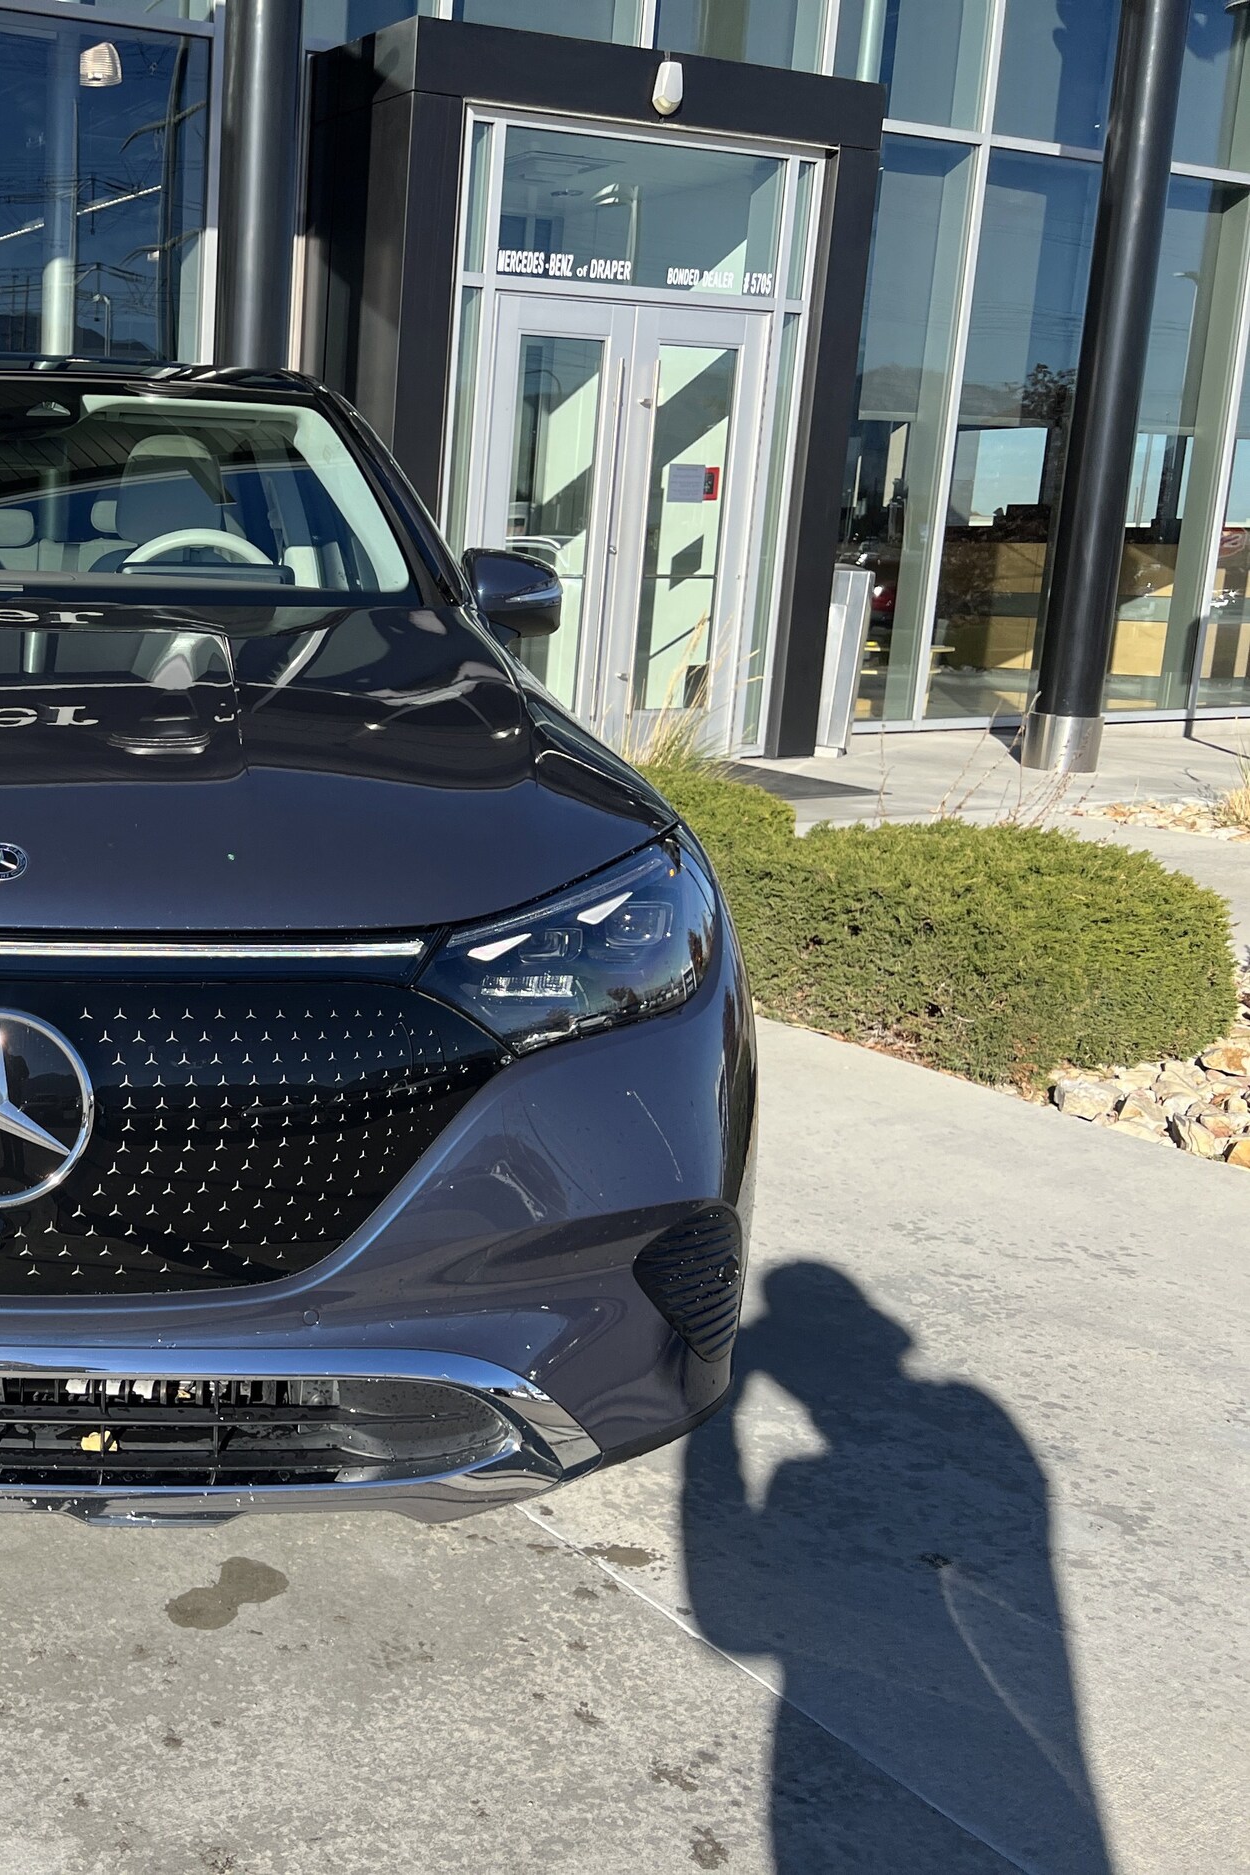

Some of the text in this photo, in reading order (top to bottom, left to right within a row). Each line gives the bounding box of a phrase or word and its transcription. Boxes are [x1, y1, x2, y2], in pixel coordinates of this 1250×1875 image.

[576, 264, 589, 277] of
[589, 258, 632, 281] DRAPER
[666, 267, 700, 286] BONDED
[701, 270, 735, 289] DEALER
